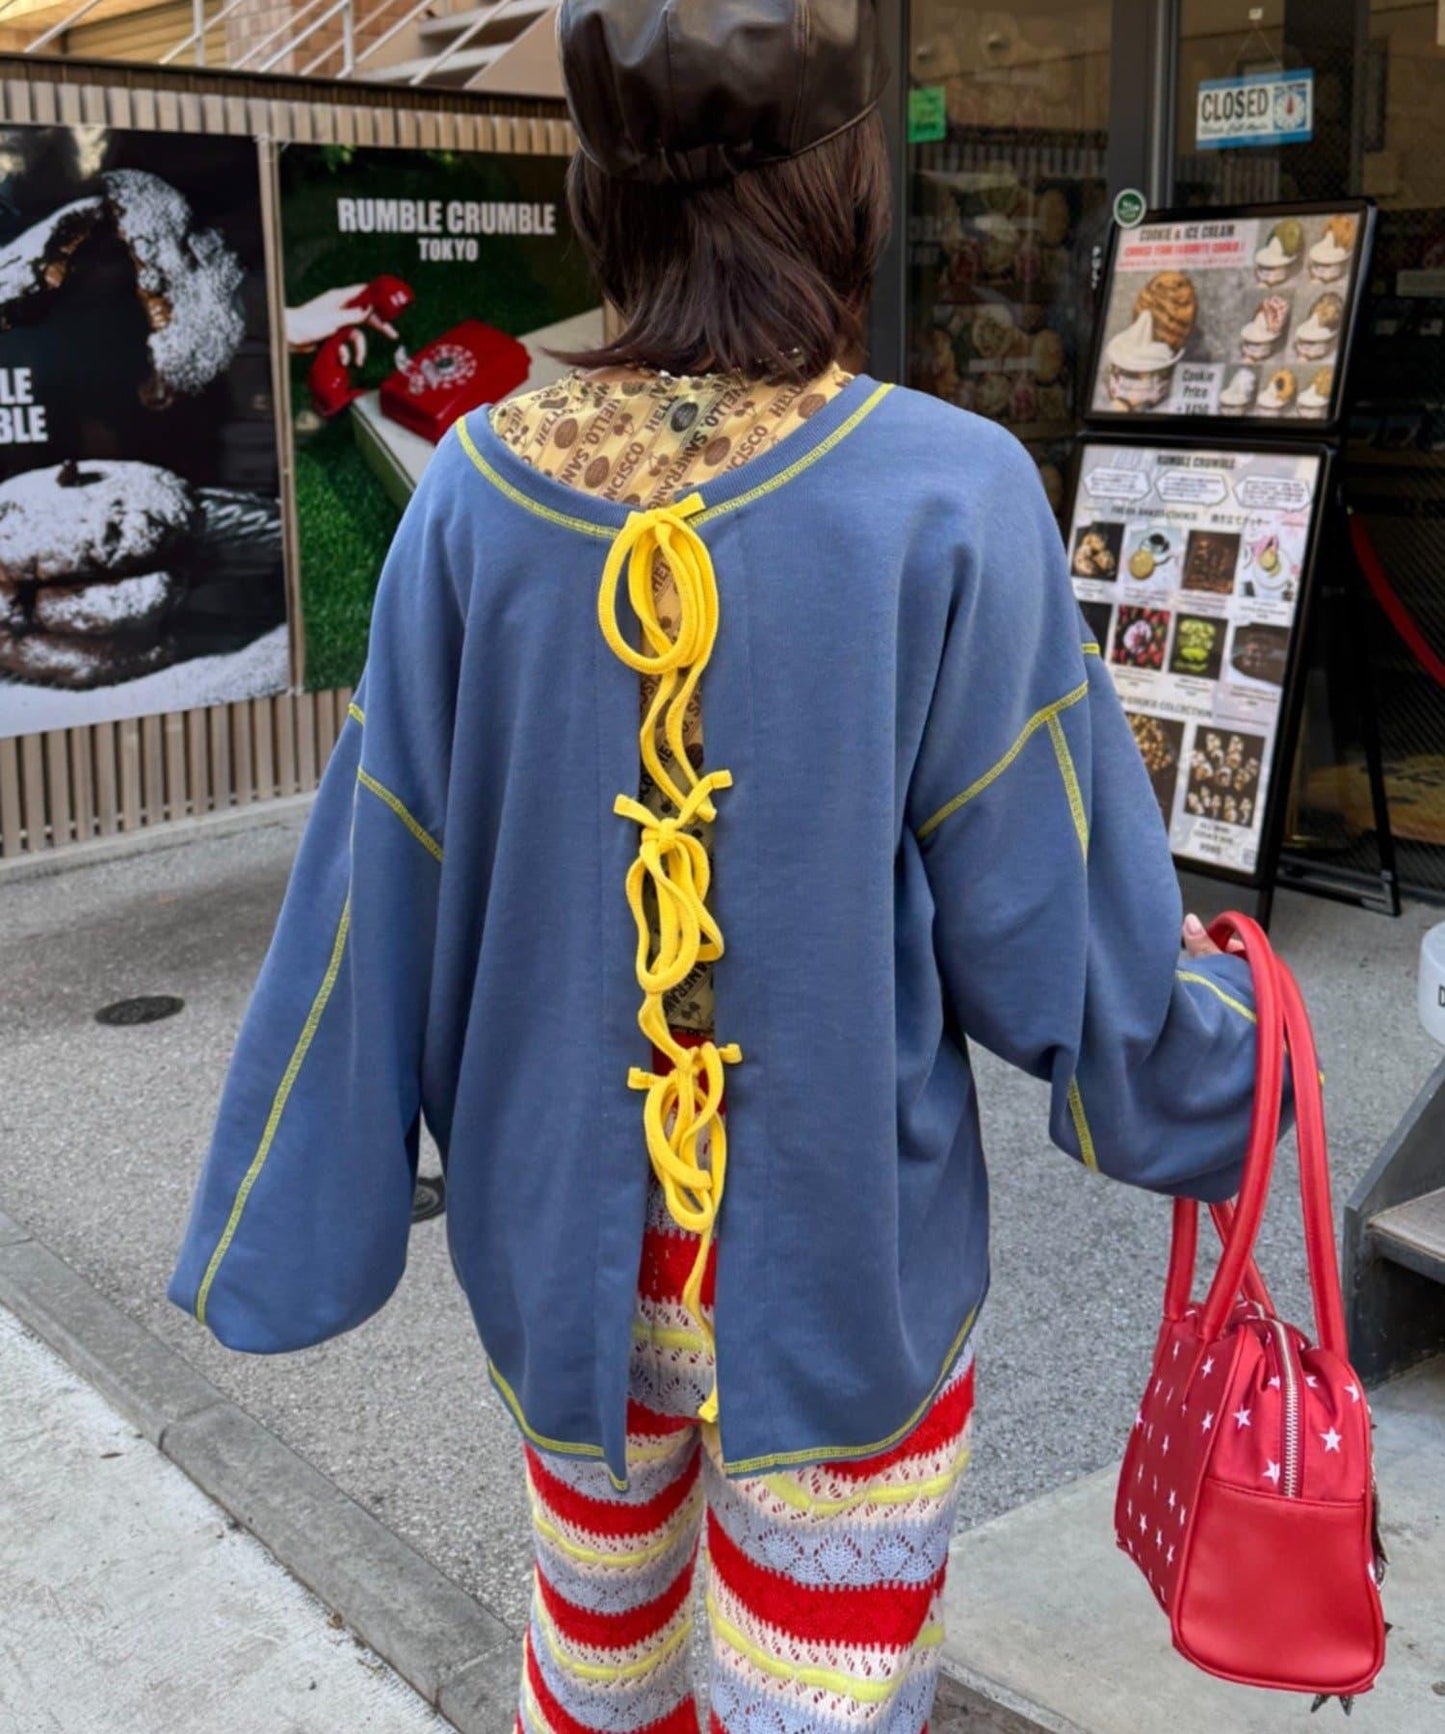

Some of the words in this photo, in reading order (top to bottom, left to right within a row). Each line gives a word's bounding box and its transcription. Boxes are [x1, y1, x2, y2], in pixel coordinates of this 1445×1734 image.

[1201, 87, 1269, 122] CLOSED
[336, 198, 443, 233] RUMBLE
[446, 201, 557, 235] CRUMBLE
[417, 238, 479, 262] TOKYO
